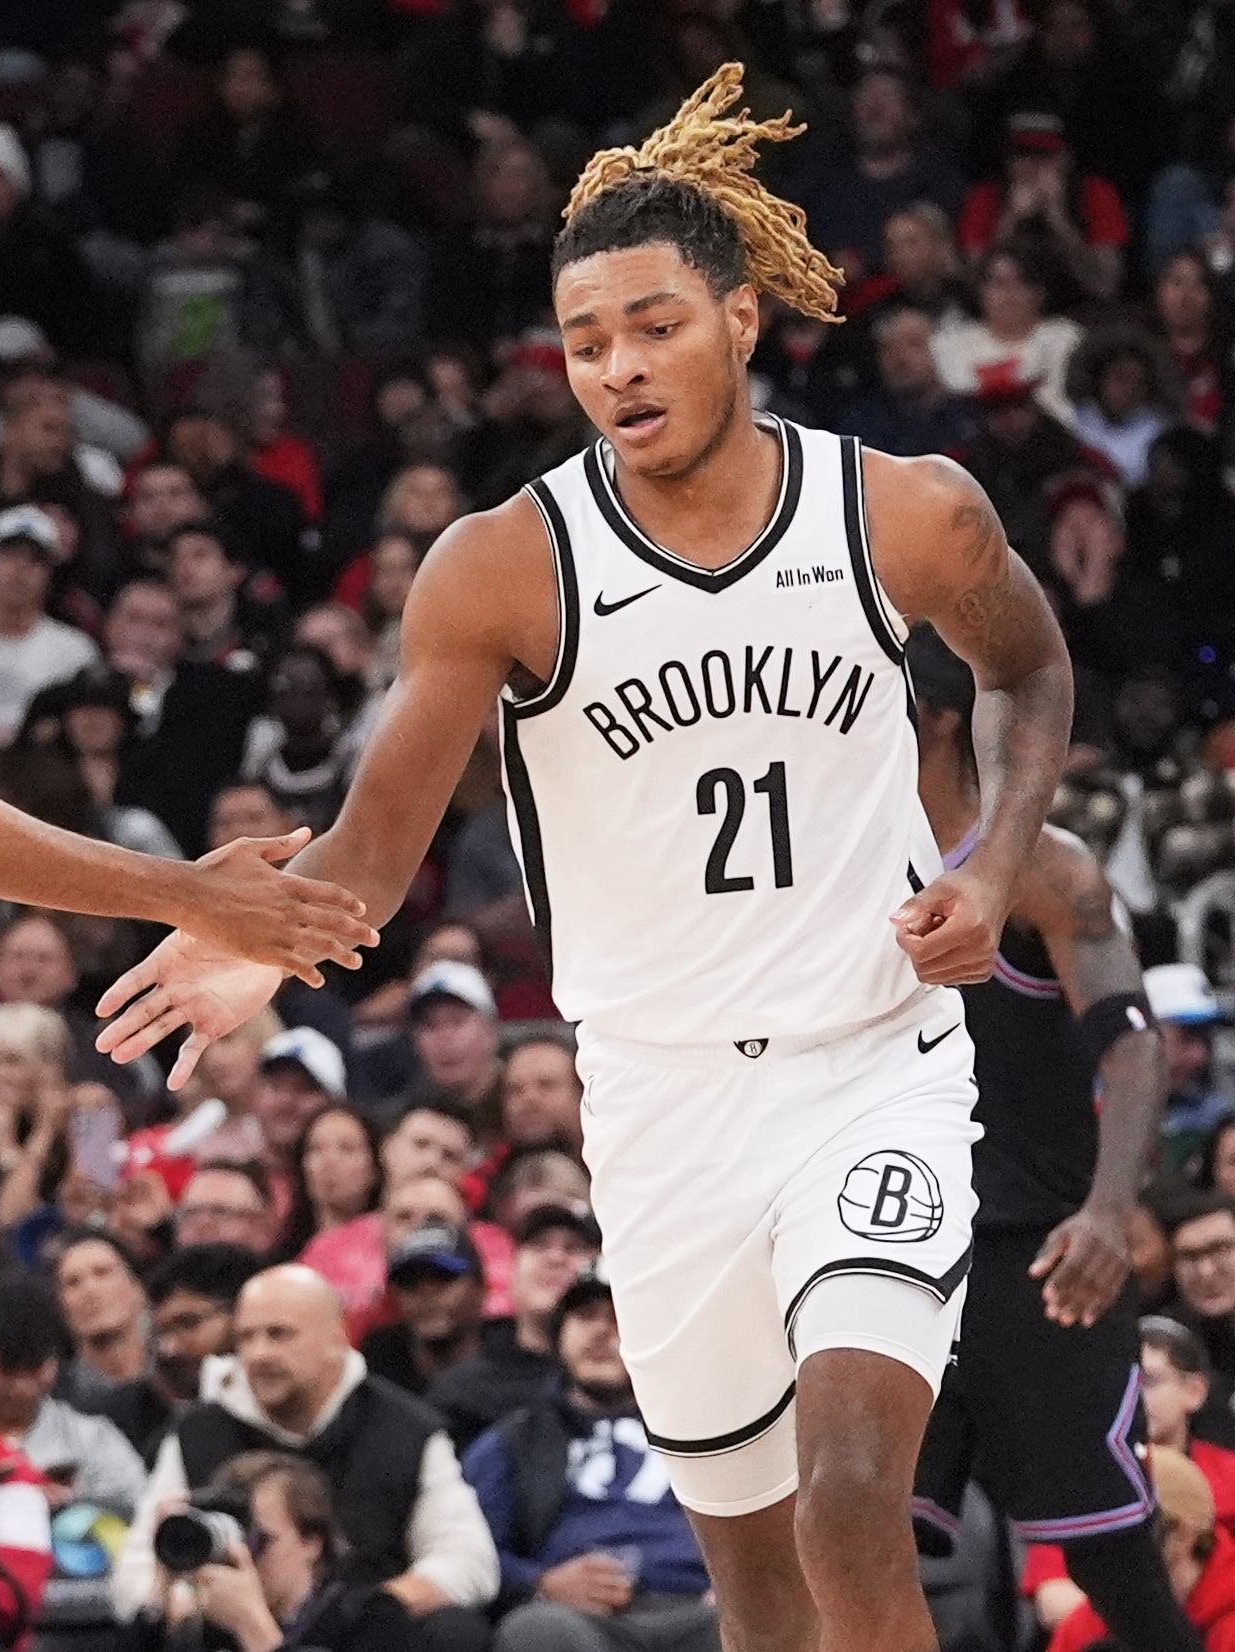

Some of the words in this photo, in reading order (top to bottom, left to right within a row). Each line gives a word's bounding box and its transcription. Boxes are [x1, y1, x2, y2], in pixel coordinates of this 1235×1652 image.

[776, 568, 795, 588] All
[797, 568, 811, 586] In
[811, 565, 844, 584] Won
[583, 645, 875, 761] BROOKLYN
[696, 760, 793, 894] 21
[870, 1164, 912, 1228] B
